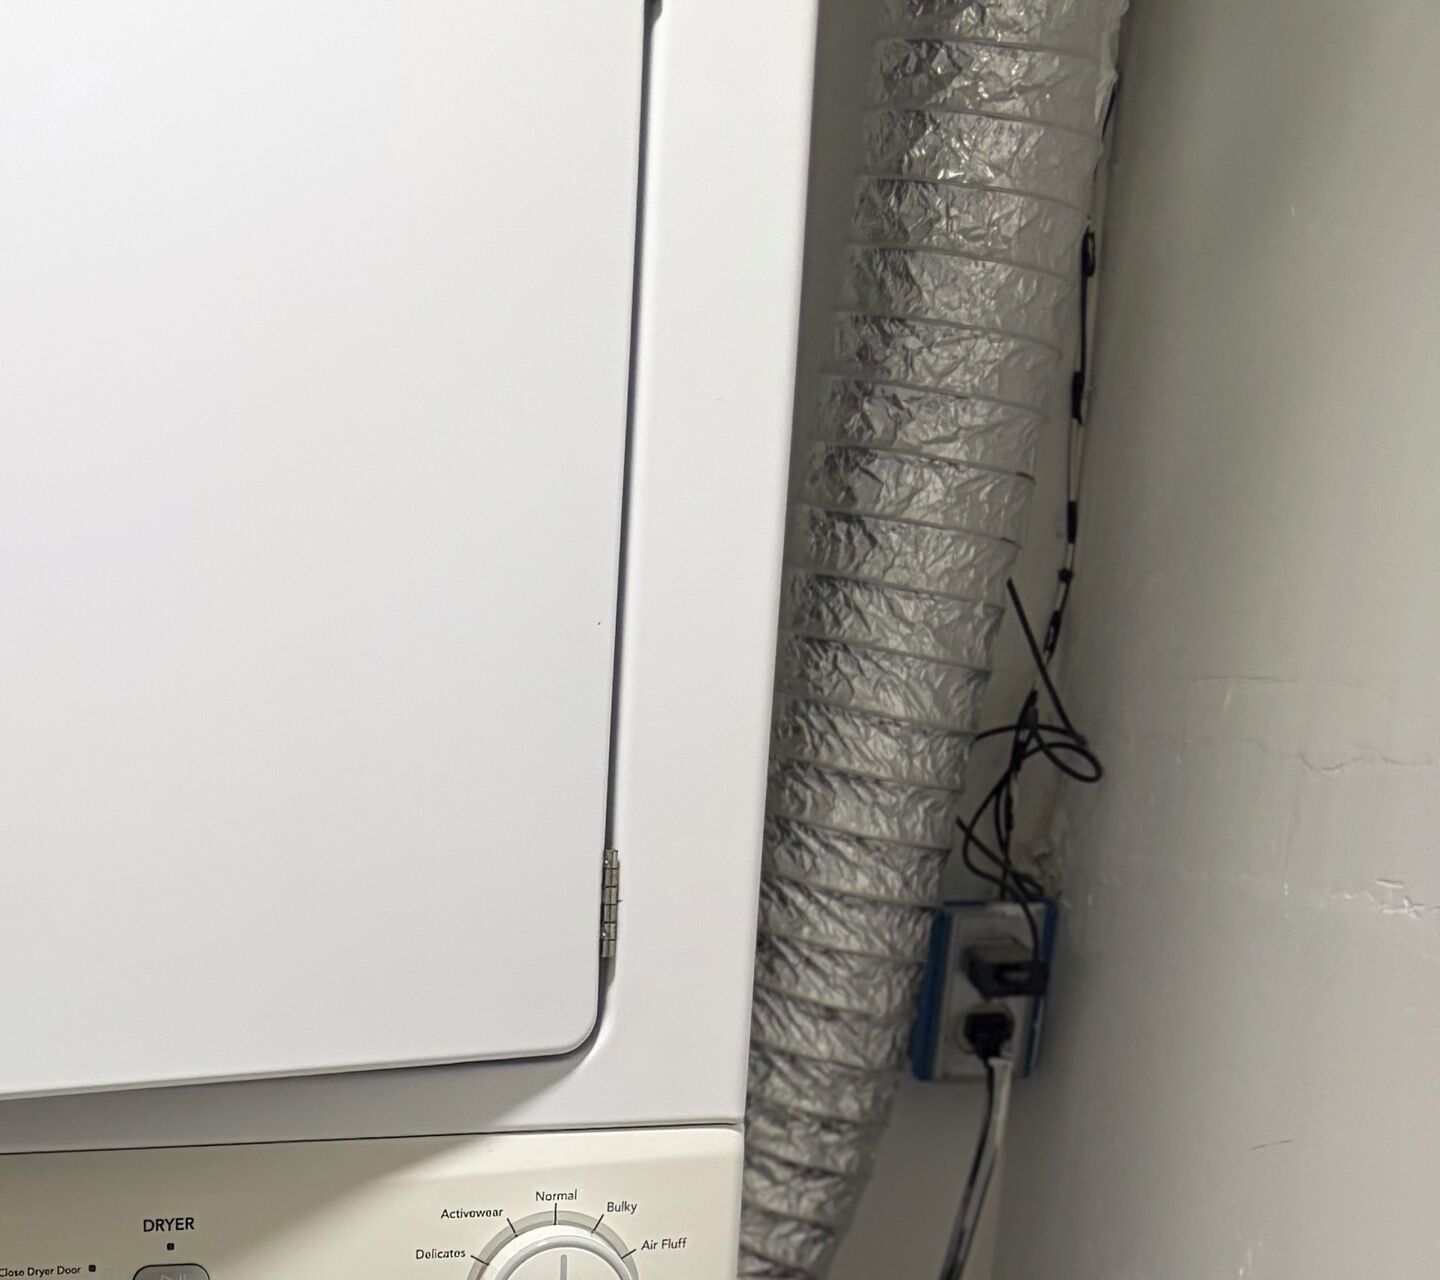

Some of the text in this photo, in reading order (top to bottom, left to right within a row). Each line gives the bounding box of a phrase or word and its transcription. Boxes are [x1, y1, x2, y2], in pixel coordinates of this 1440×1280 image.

[535, 1189, 577, 1202] Normal
[440, 1207, 503, 1219] Activewear
[606, 1201, 637, 1214] Bulky
[143, 1217, 195, 1232] DRYER
[641, 1238, 687, 1250] Air Fluff
[415, 1248, 466, 1259] Delicates
[27, 1266, 54, 1278] Dryer
[56, 1265, 81, 1275] Door
